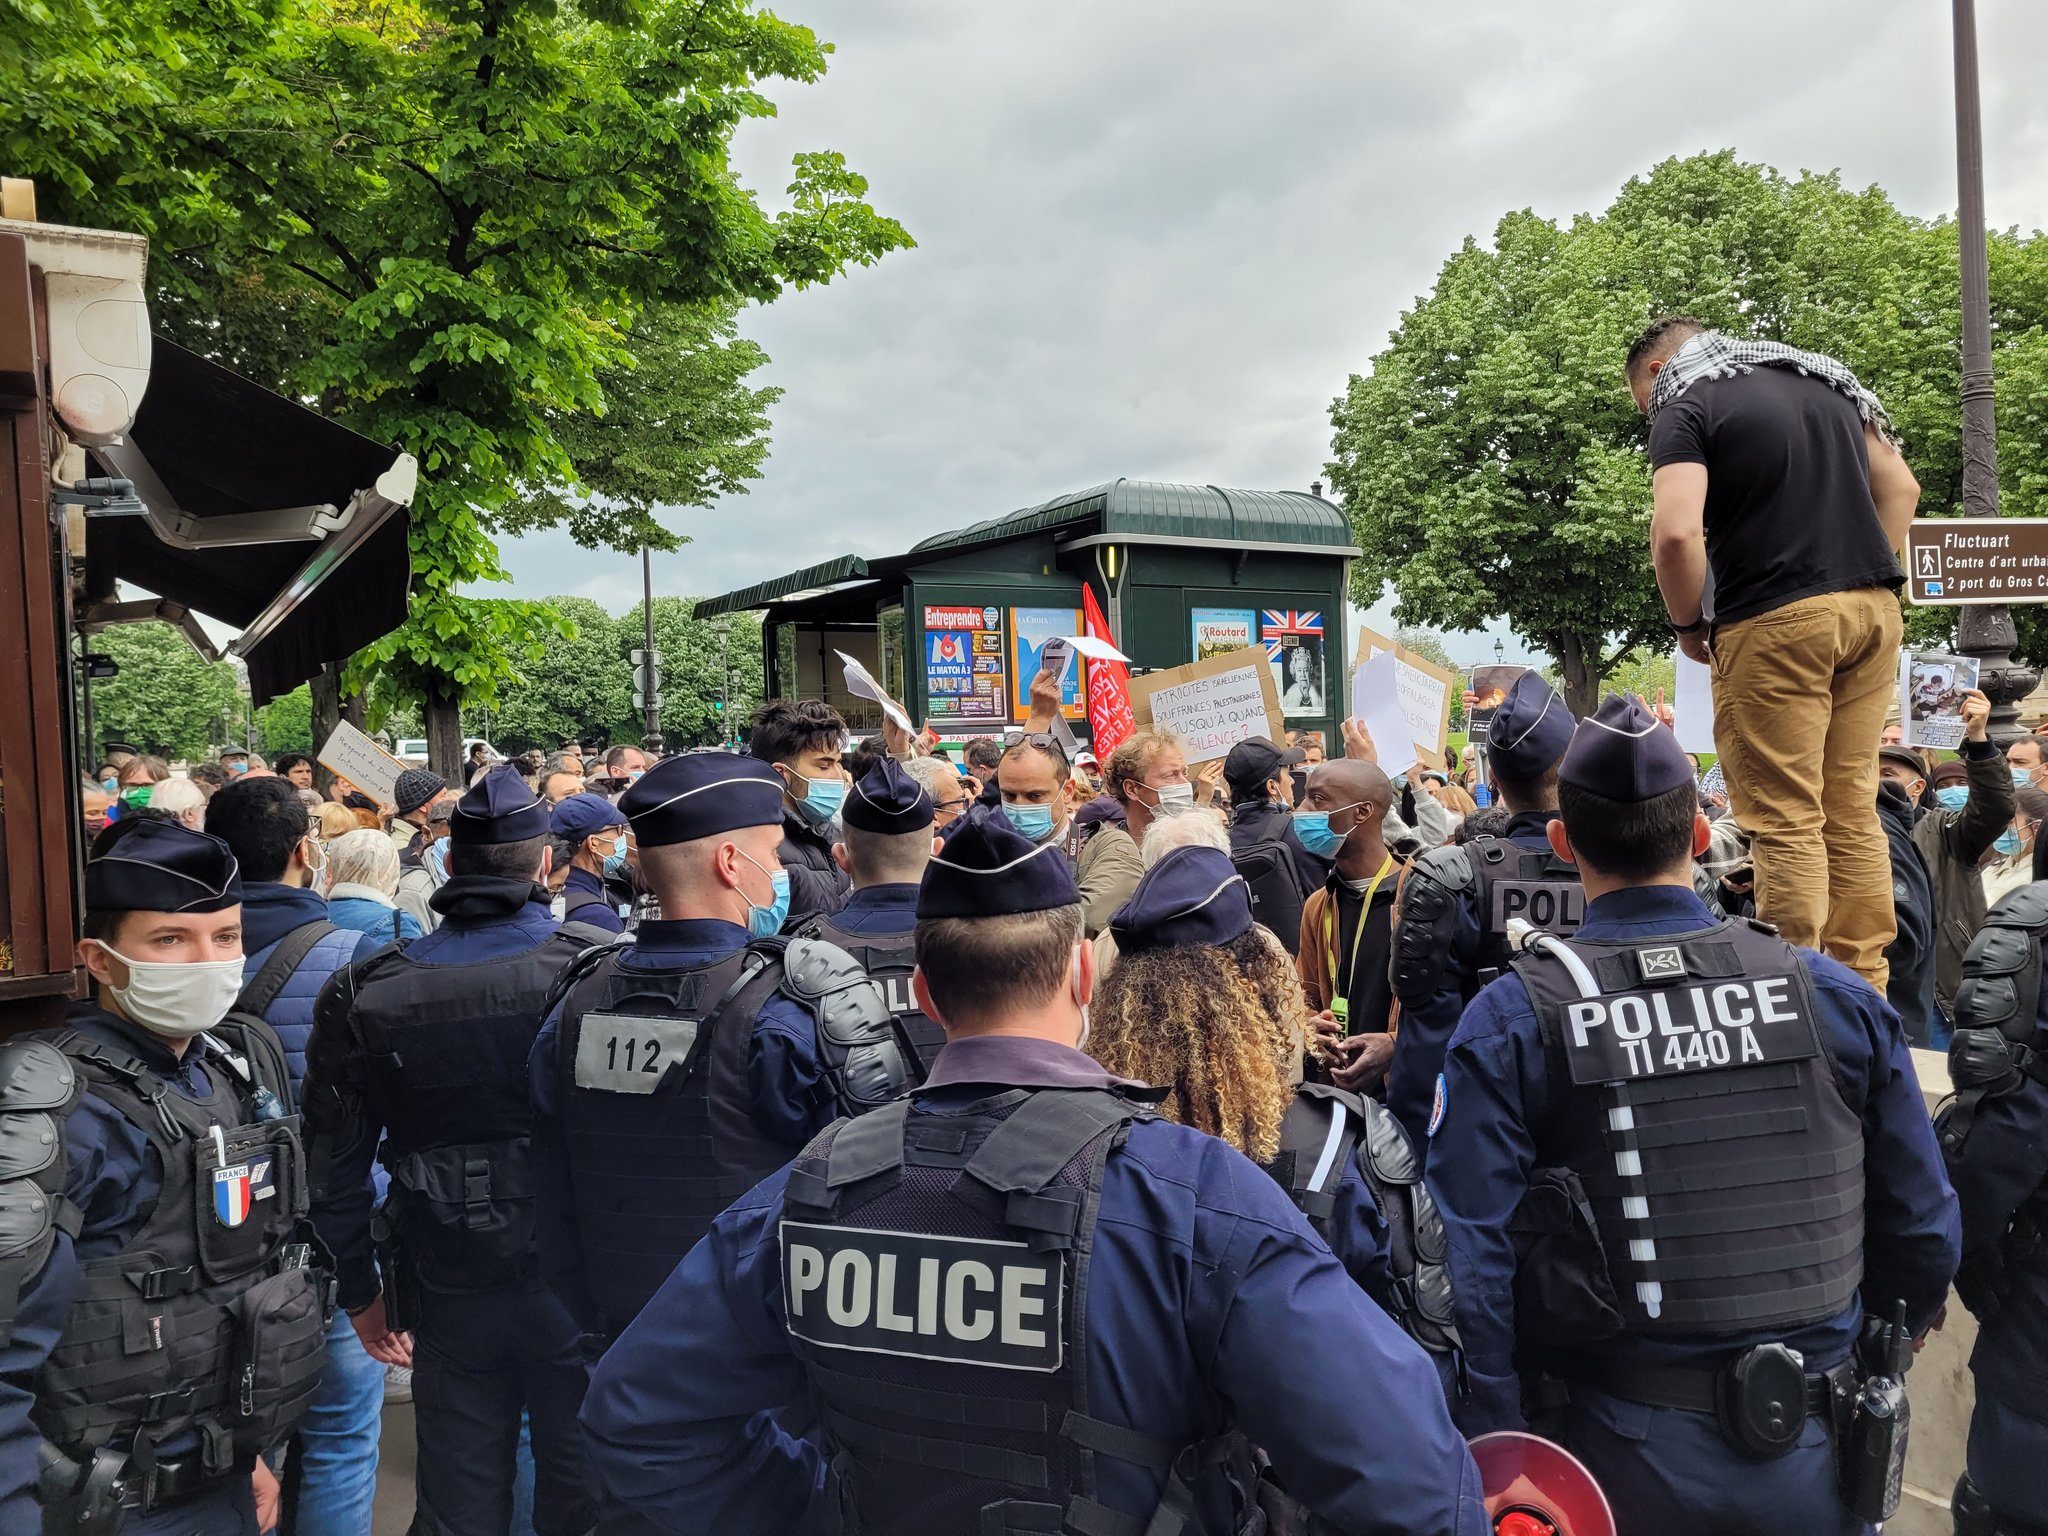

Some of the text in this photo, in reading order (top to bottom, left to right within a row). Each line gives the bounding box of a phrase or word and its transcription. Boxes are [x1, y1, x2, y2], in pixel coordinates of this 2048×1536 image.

[1944, 533, 2010, 548] Fluctuart
[1946, 556, 1984, 569] Centre
[1989, 555, 2017, 568] d'art
[1947, 576, 1955, 589] 2
[1959, 577, 1984, 592] port
[1989, 576, 2003, 589] du
[2007, 575, 2033, 588] Gros
[925, 607, 981, 629] Entreprendre
[1209, 626, 1246, 637] Routard
[927, 663, 971, 675] LE MATCH À 3
[1155, 700, 1211, 724] SOUFFRANCES
[1228, 705, 1266, 723] QUAND
[338, 736, 367, 760] Respect
[1188, 729, 1238, 752] SILENCE
[1503, 888, 1580, 926] POL
[1567, 977, 1799, 1048] POLICE
[606, 1036, 662, 1074] 112
[1618, 1026, 1765, 1076] TI 440 A
[217, 1167, 248, 1181] FRANCE
[789, 1242, 1047, 1348] POLICE
